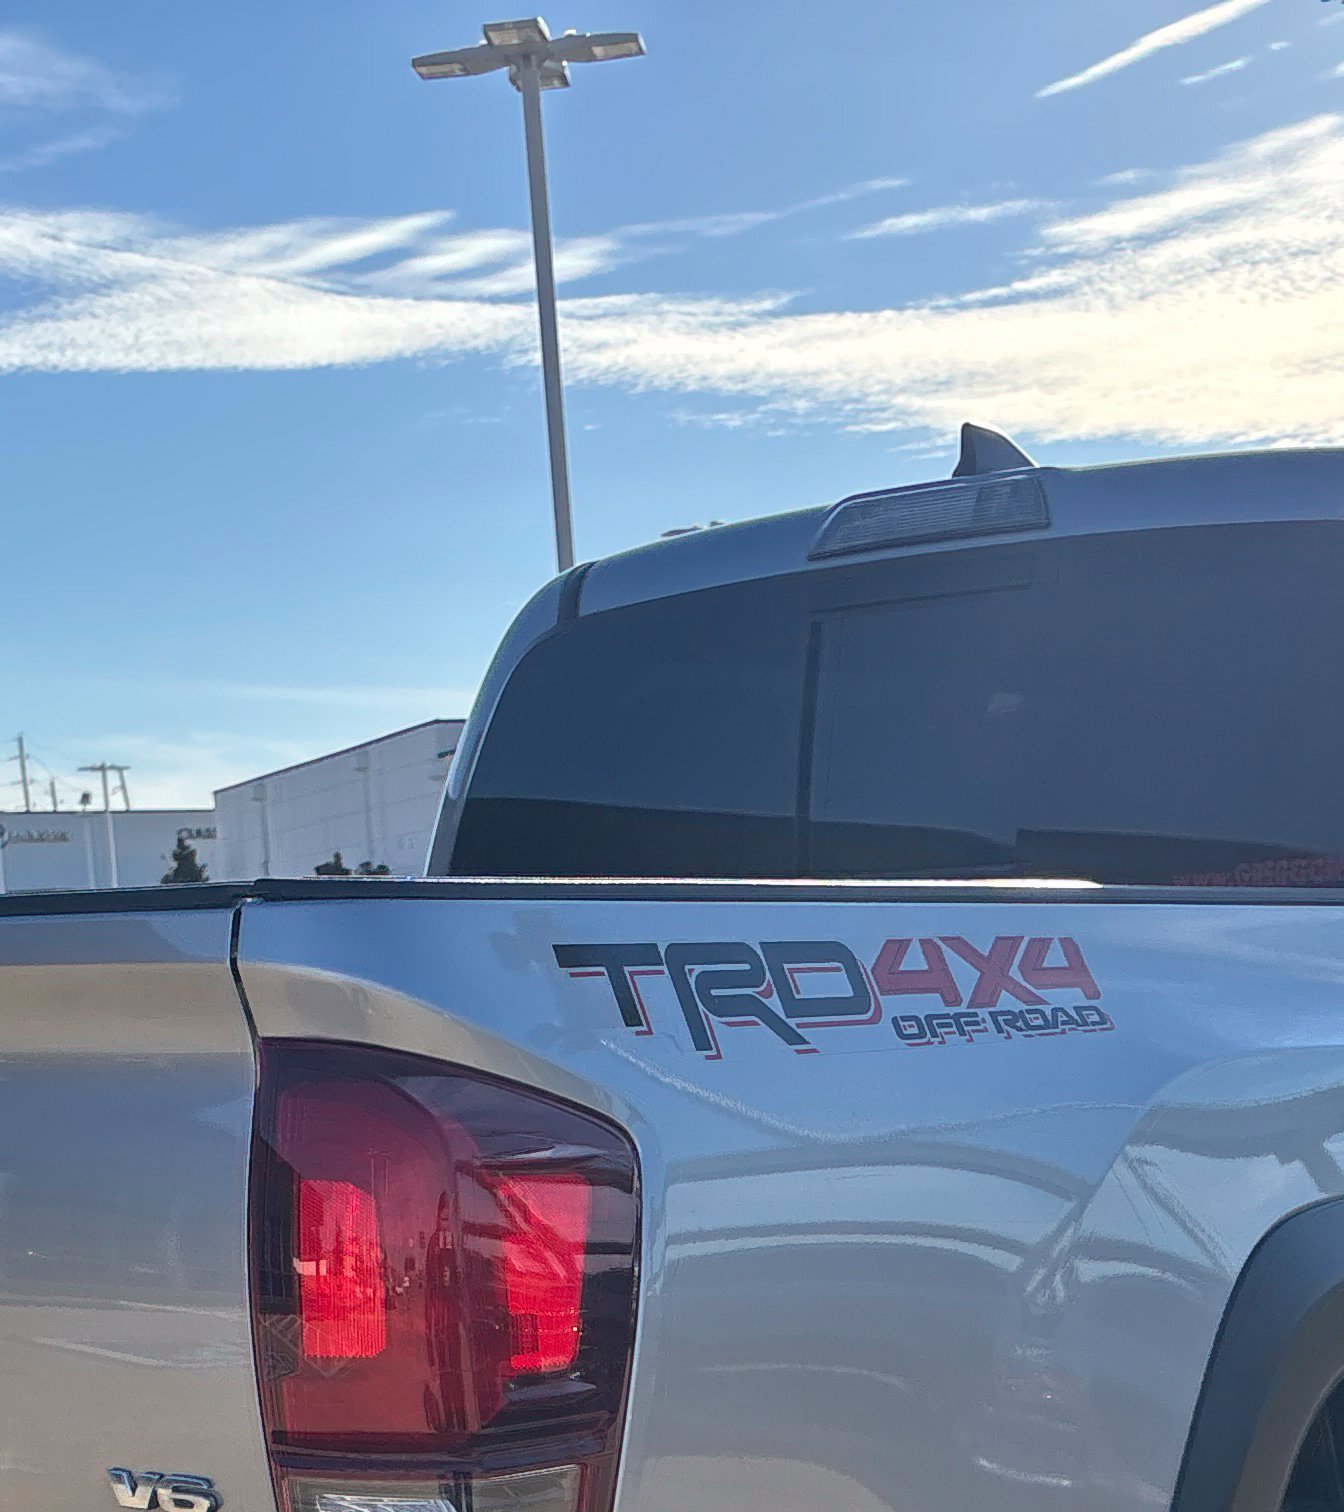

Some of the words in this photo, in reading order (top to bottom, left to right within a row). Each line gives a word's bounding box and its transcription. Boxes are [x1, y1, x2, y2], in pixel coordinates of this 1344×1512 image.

[551, 940, 883, 1061] TRD
[870, 935, 1102, 1010] 4X4
[890, 1012, 986, 1048] OFF
[988, 1004, 1117, 1039] ROAD
